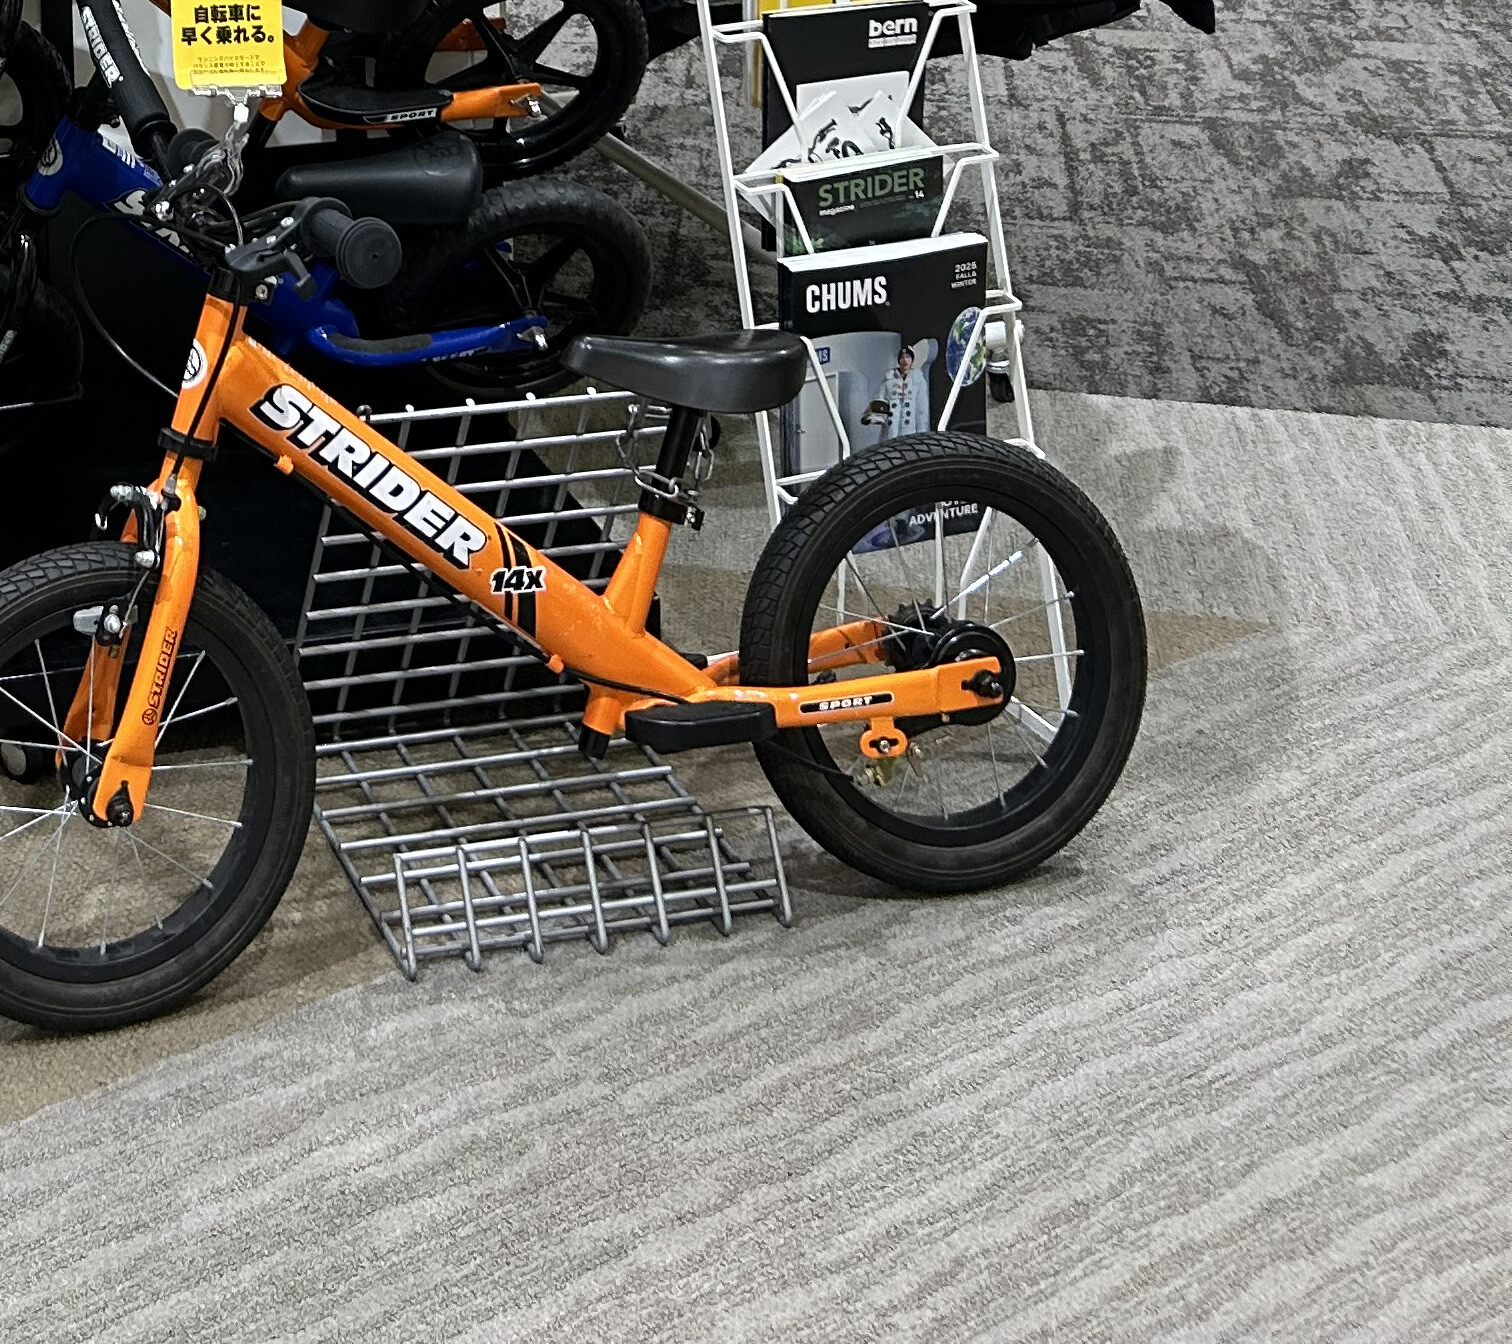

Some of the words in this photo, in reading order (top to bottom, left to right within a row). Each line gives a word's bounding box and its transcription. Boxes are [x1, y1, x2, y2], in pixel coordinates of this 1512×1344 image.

[193, 4, 261, 24] 自転車に
[181, 25, 275, 46] 早く乗れる。
[868, 17, 919, 38] bern
[390, 110, 434, 121] SPORT
[818, 167, 925, 208] STRIDER
[806, 275, 887, 313] CHUMS
[249, 382, 488, 570] STRIDER
[908, 502, 979, 527] ADVNTURE
[148, 626, 178, 710] STRIDER
[818, 694, 874, 712] SPORT
